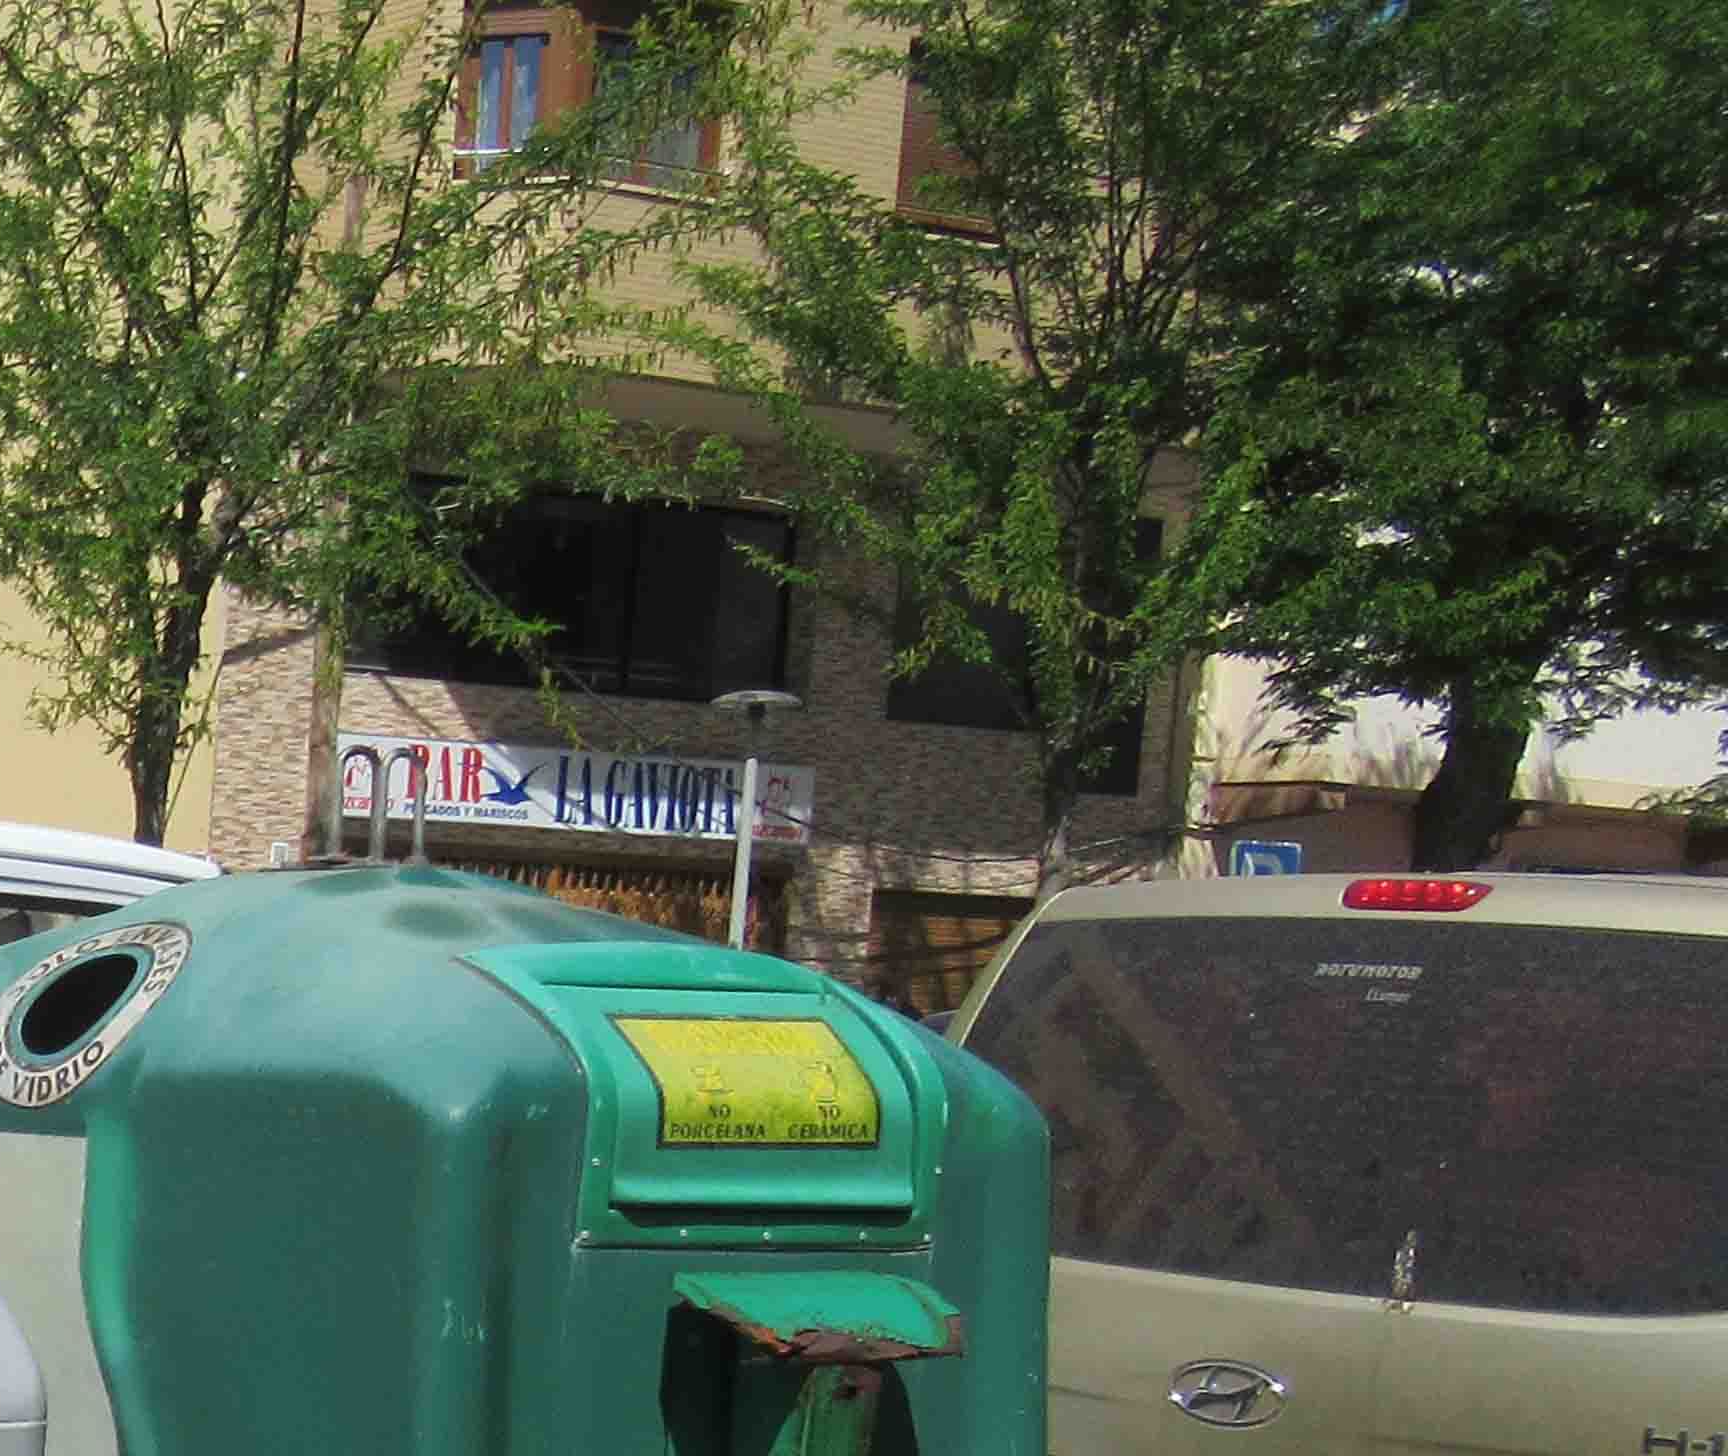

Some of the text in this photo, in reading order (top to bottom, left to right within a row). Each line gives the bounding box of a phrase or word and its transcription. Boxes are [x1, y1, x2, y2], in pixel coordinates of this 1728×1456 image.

[403, 804, 460, 817] PECADOS
[555, 756, 592, 825] LA
[605, 760, 738, 834] GAVIOTA
[13, 1041, 104, 1102] VIDRIO
[670, 1123, 767, 1139] PORCELANA
